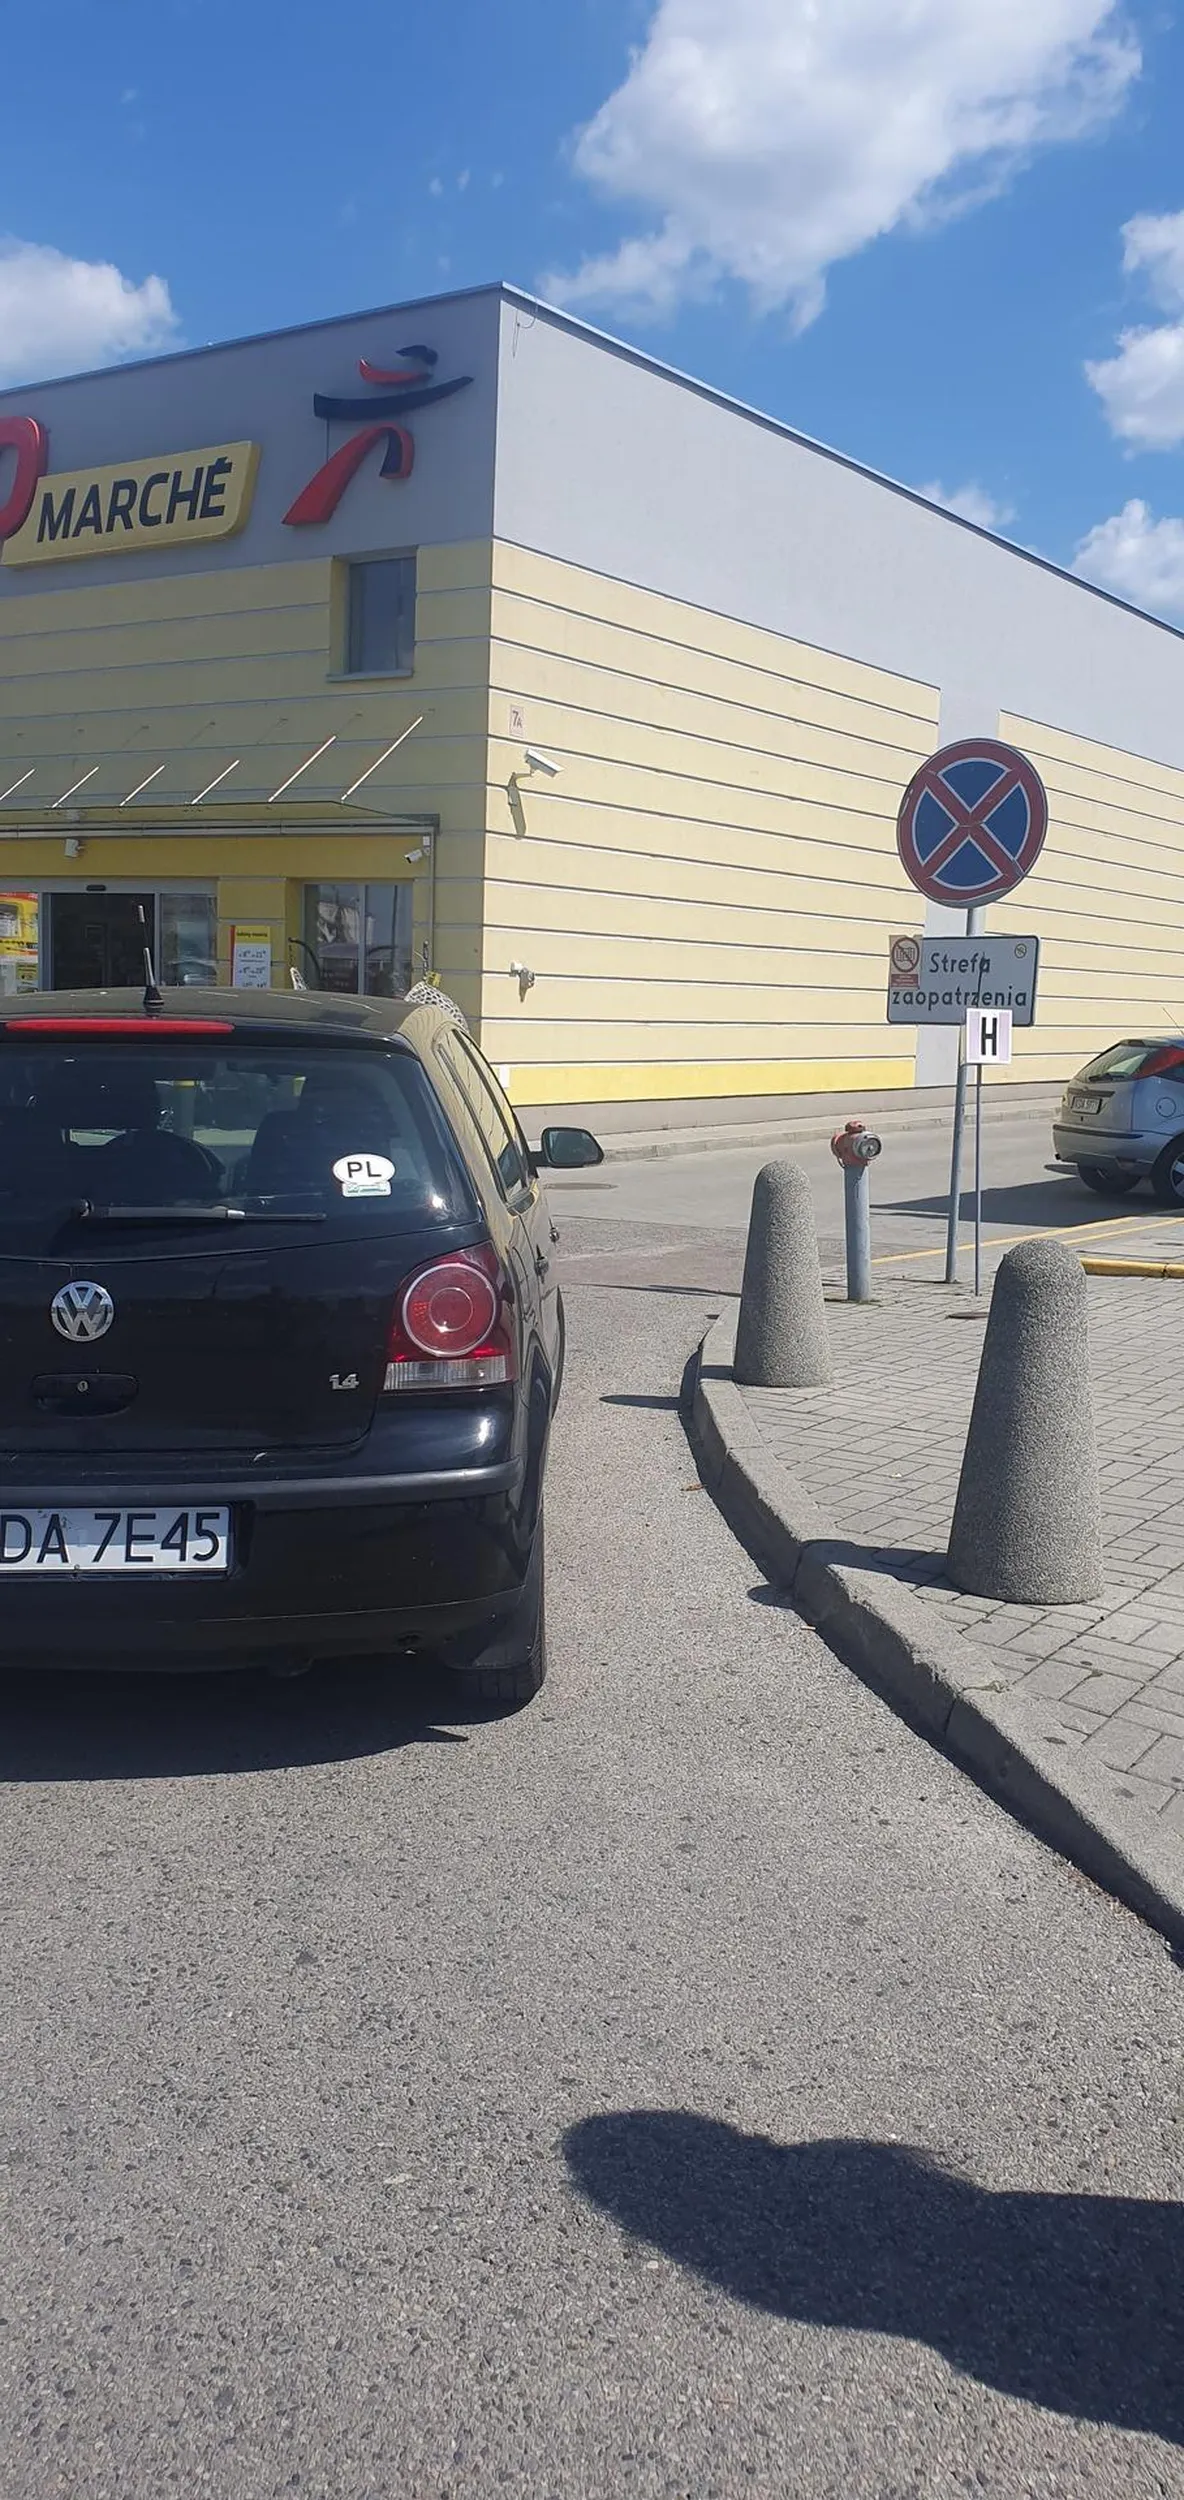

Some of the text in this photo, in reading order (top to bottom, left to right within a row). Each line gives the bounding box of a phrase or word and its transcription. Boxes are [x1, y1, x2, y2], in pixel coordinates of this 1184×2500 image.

[37, 456, 233, 543] MARCHÉ
[929, 952, 991, 973] Strefa
[892, 986, 1027, 1011] zaopatrzenia
[981, 1016, 998, 1056] H
[347, 1161, 382, 1178] PL
[92, 1512, 220, 1562] 7E45
